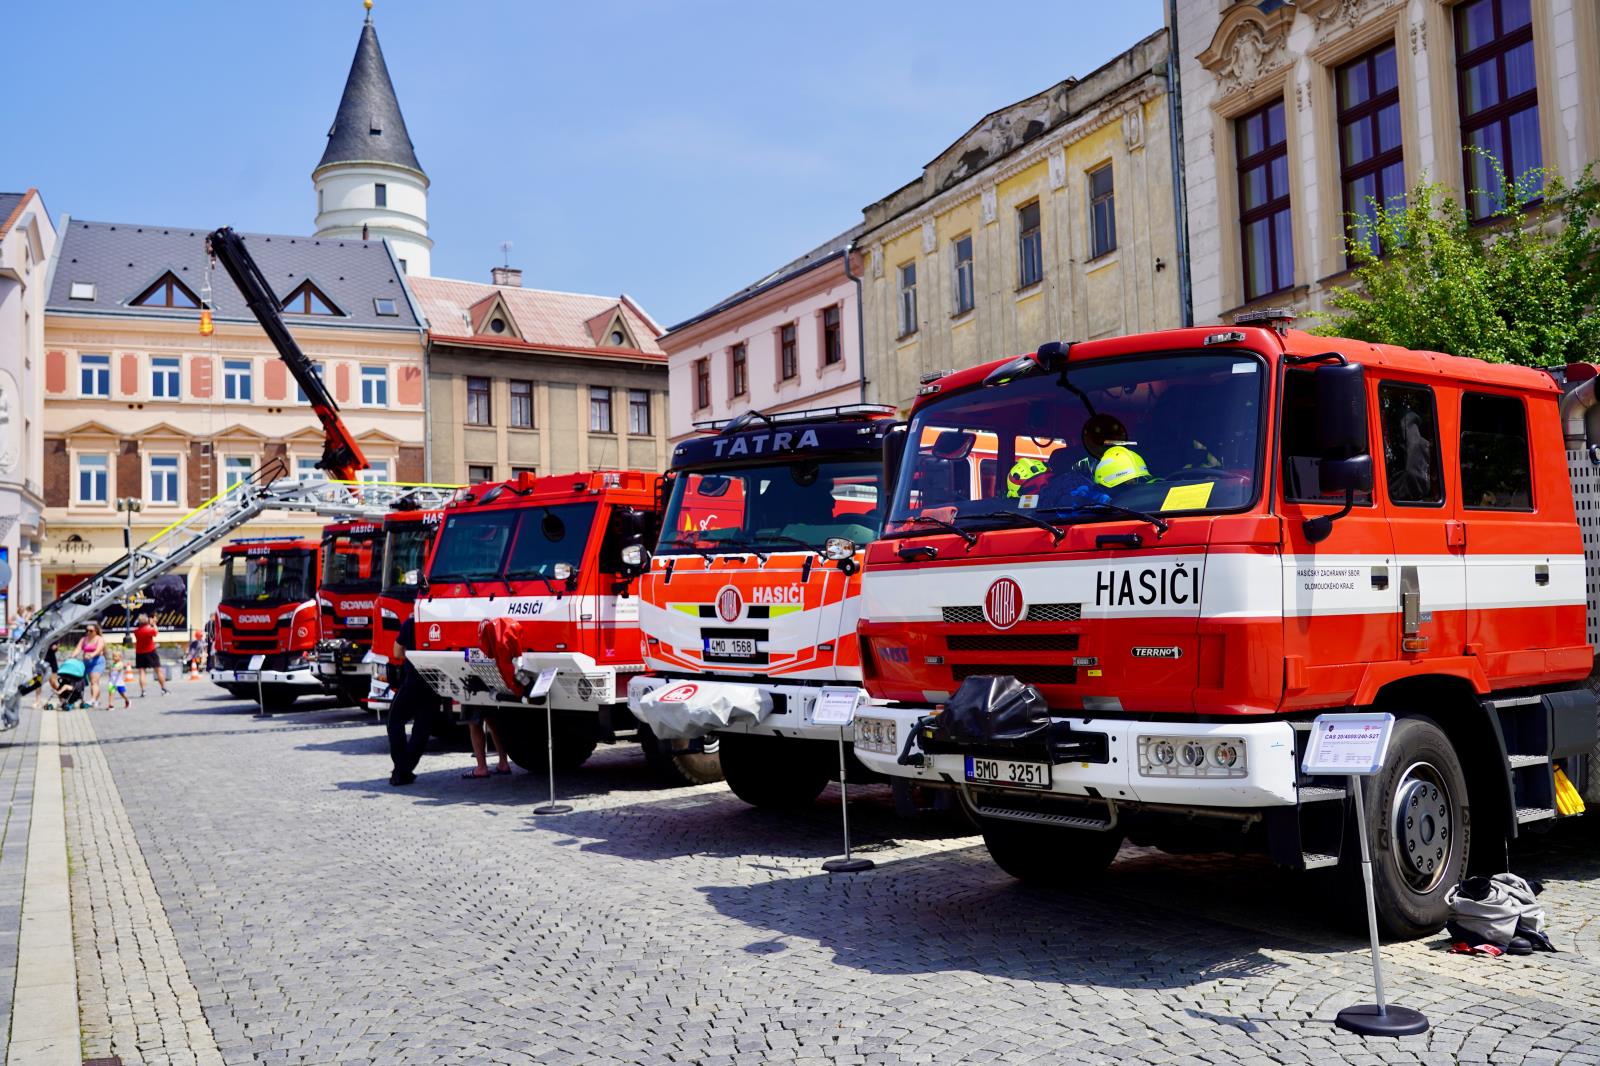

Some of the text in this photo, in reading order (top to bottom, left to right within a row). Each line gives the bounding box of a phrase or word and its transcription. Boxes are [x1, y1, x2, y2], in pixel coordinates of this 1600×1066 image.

[713, 429, 819, 457] TATRA
[350, 524, 374, 533] HASIČI
[1348, 569, 1360, 577] SBOR
[1095, 563, 1199, 606] HASIČI
[1340, 582, 1354, 590] KRAJE
[752, 582, 805, 604] HASIČI
[340, 600, 375, 610] SCANIA
[507, 600, 543, 615] HASIČI
[991, 581, 1015, 625] TATRA
[238, 614, 271, 623] SCANIA
[731, 641, 752, 653] 1568
[1008, 763, 1042, 783] 3251
